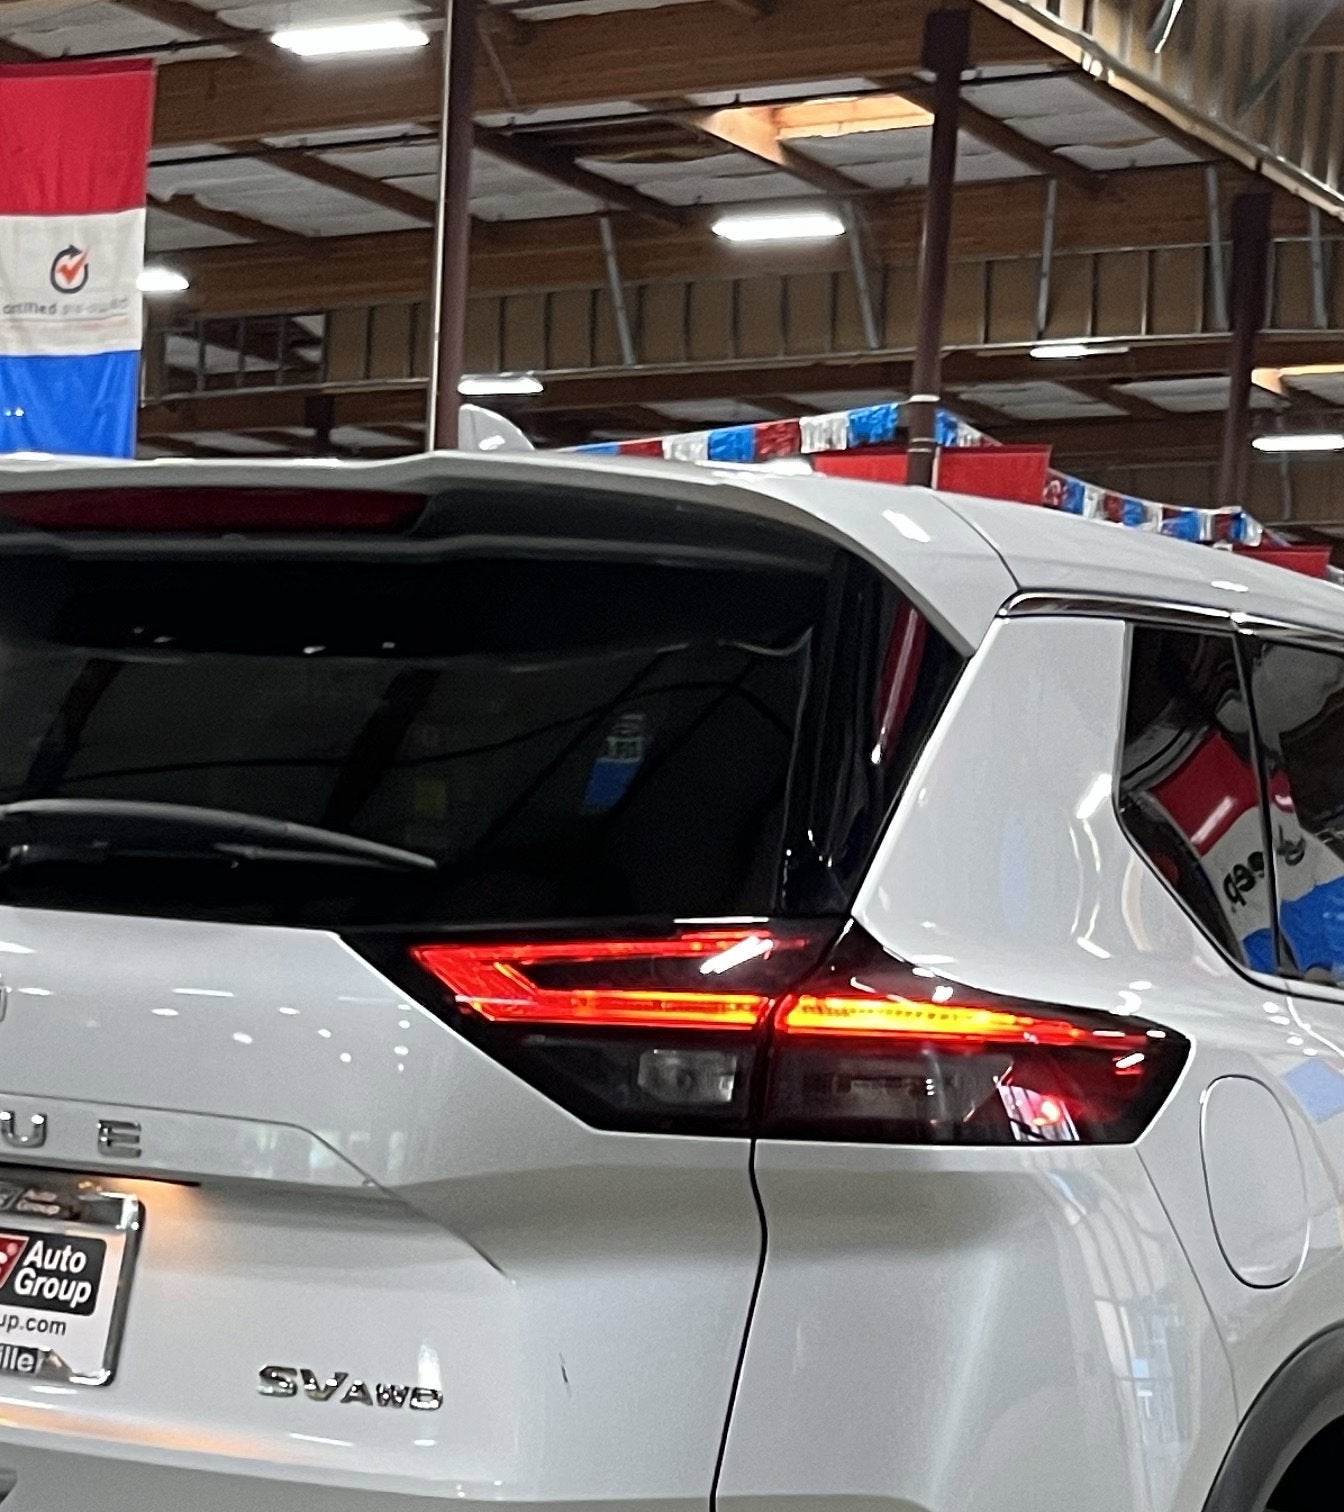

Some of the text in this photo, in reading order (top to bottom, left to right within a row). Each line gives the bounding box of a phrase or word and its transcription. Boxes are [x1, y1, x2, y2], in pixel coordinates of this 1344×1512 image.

[23, 1240, 86, 1274] Auto
[14, 1268, 92, 1308] Group
[257, 1365, 444, 1411] SV AWD
